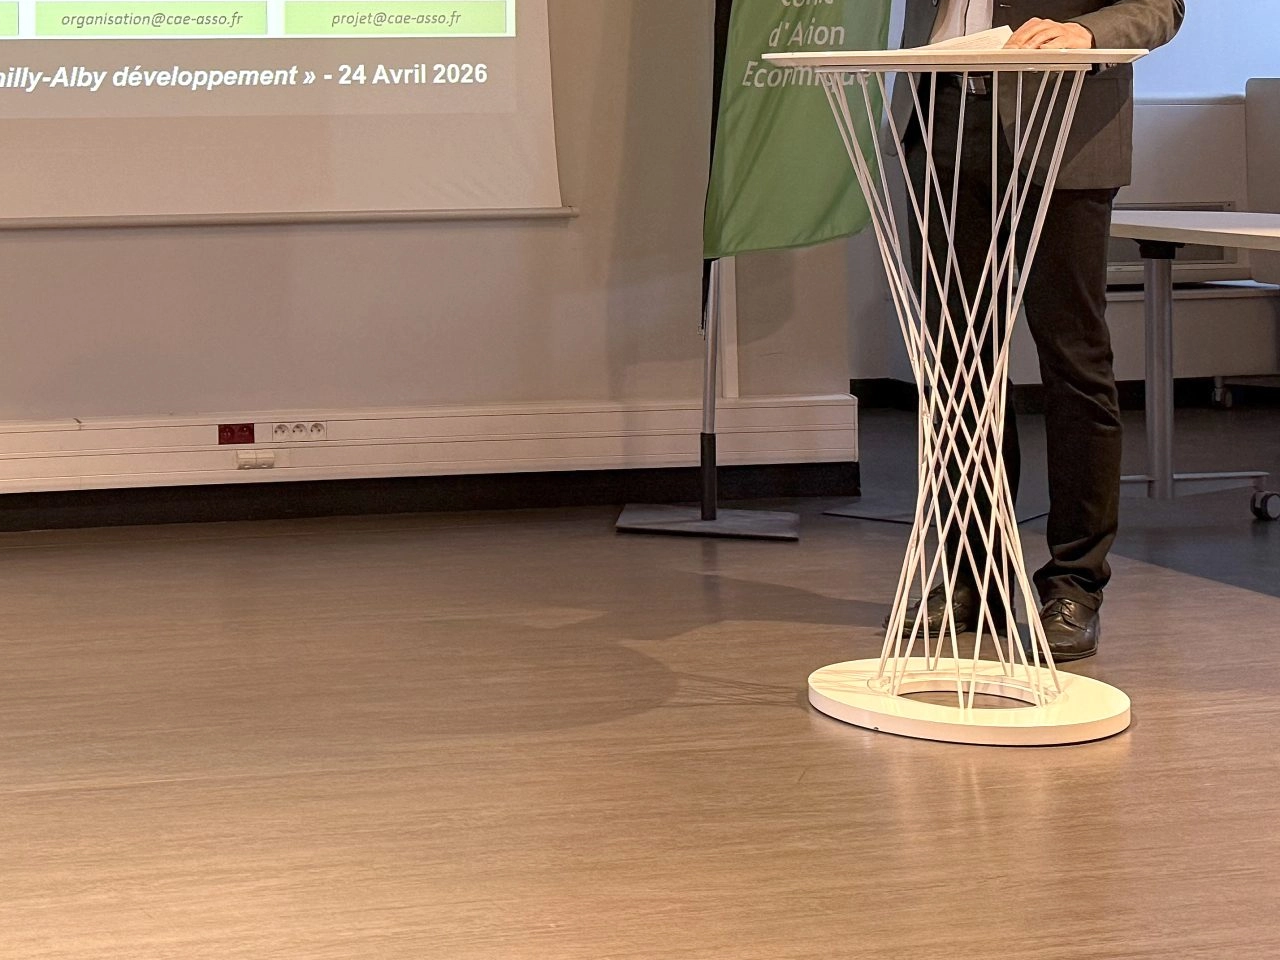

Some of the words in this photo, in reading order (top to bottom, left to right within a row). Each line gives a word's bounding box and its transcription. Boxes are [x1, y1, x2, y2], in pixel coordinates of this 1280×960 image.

[61, 10, 243, 29] organisation@cae-asso.fr
[331, 10, 462, 29] projet@cae-asso.fr
[113, 64, 298, 92] développement
[338, 64, 367, 86] 24
[372, 63, 427, 85] Avril
[432, 62, 489, 85] 2026
